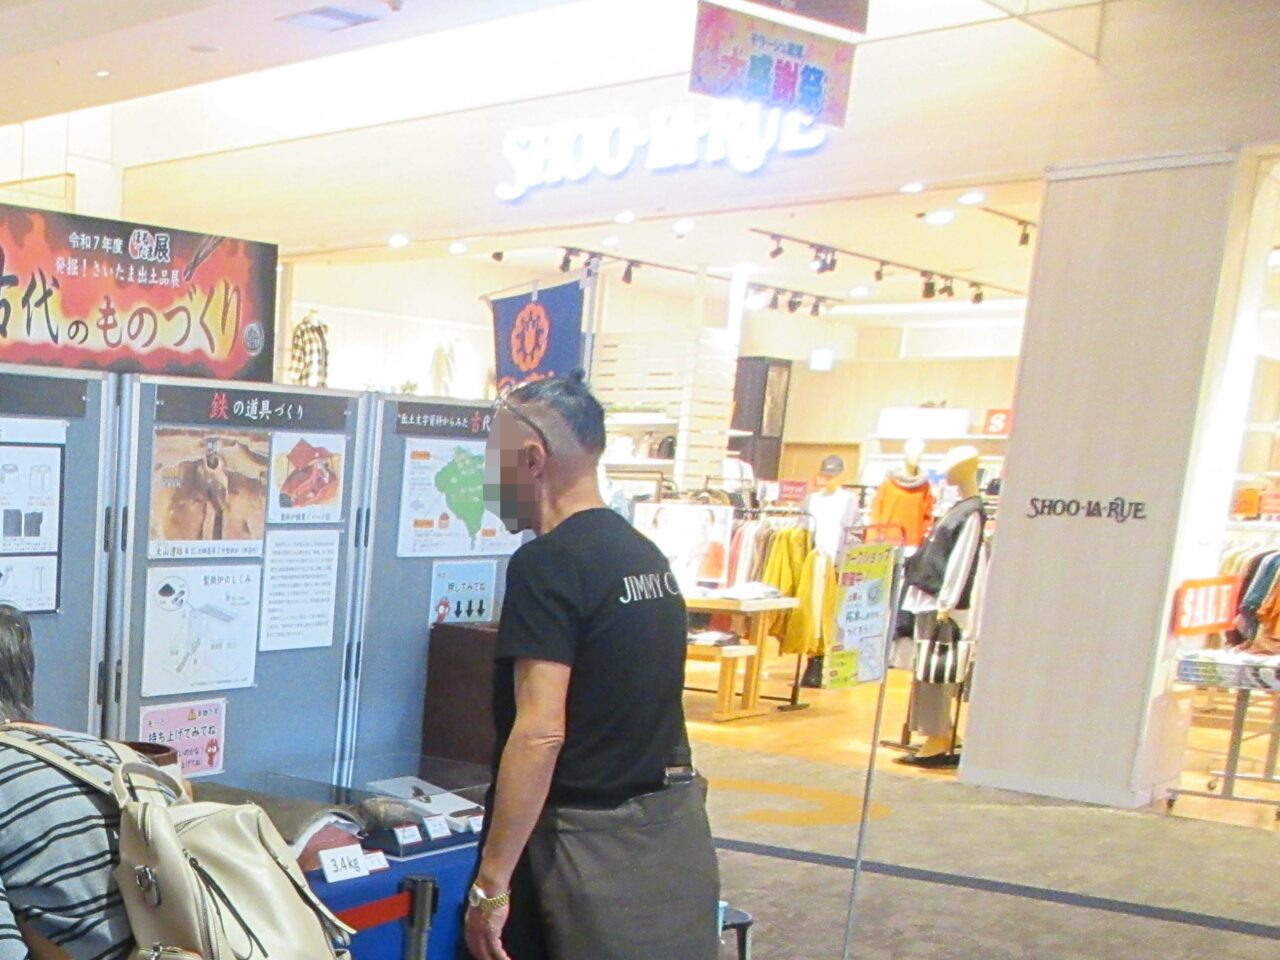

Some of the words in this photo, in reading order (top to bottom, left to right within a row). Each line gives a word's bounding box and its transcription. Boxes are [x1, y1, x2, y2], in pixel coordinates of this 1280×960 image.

[69, 231, 124, 256] 令和7年度
[209, 393, 305, 421] 鉄の道具づくり
[448, 582, 486, 593] 押してみてね
[618, 573, 664, 604] JIMMY
[148, 725, 217, 743] 持ち上げてみてね
